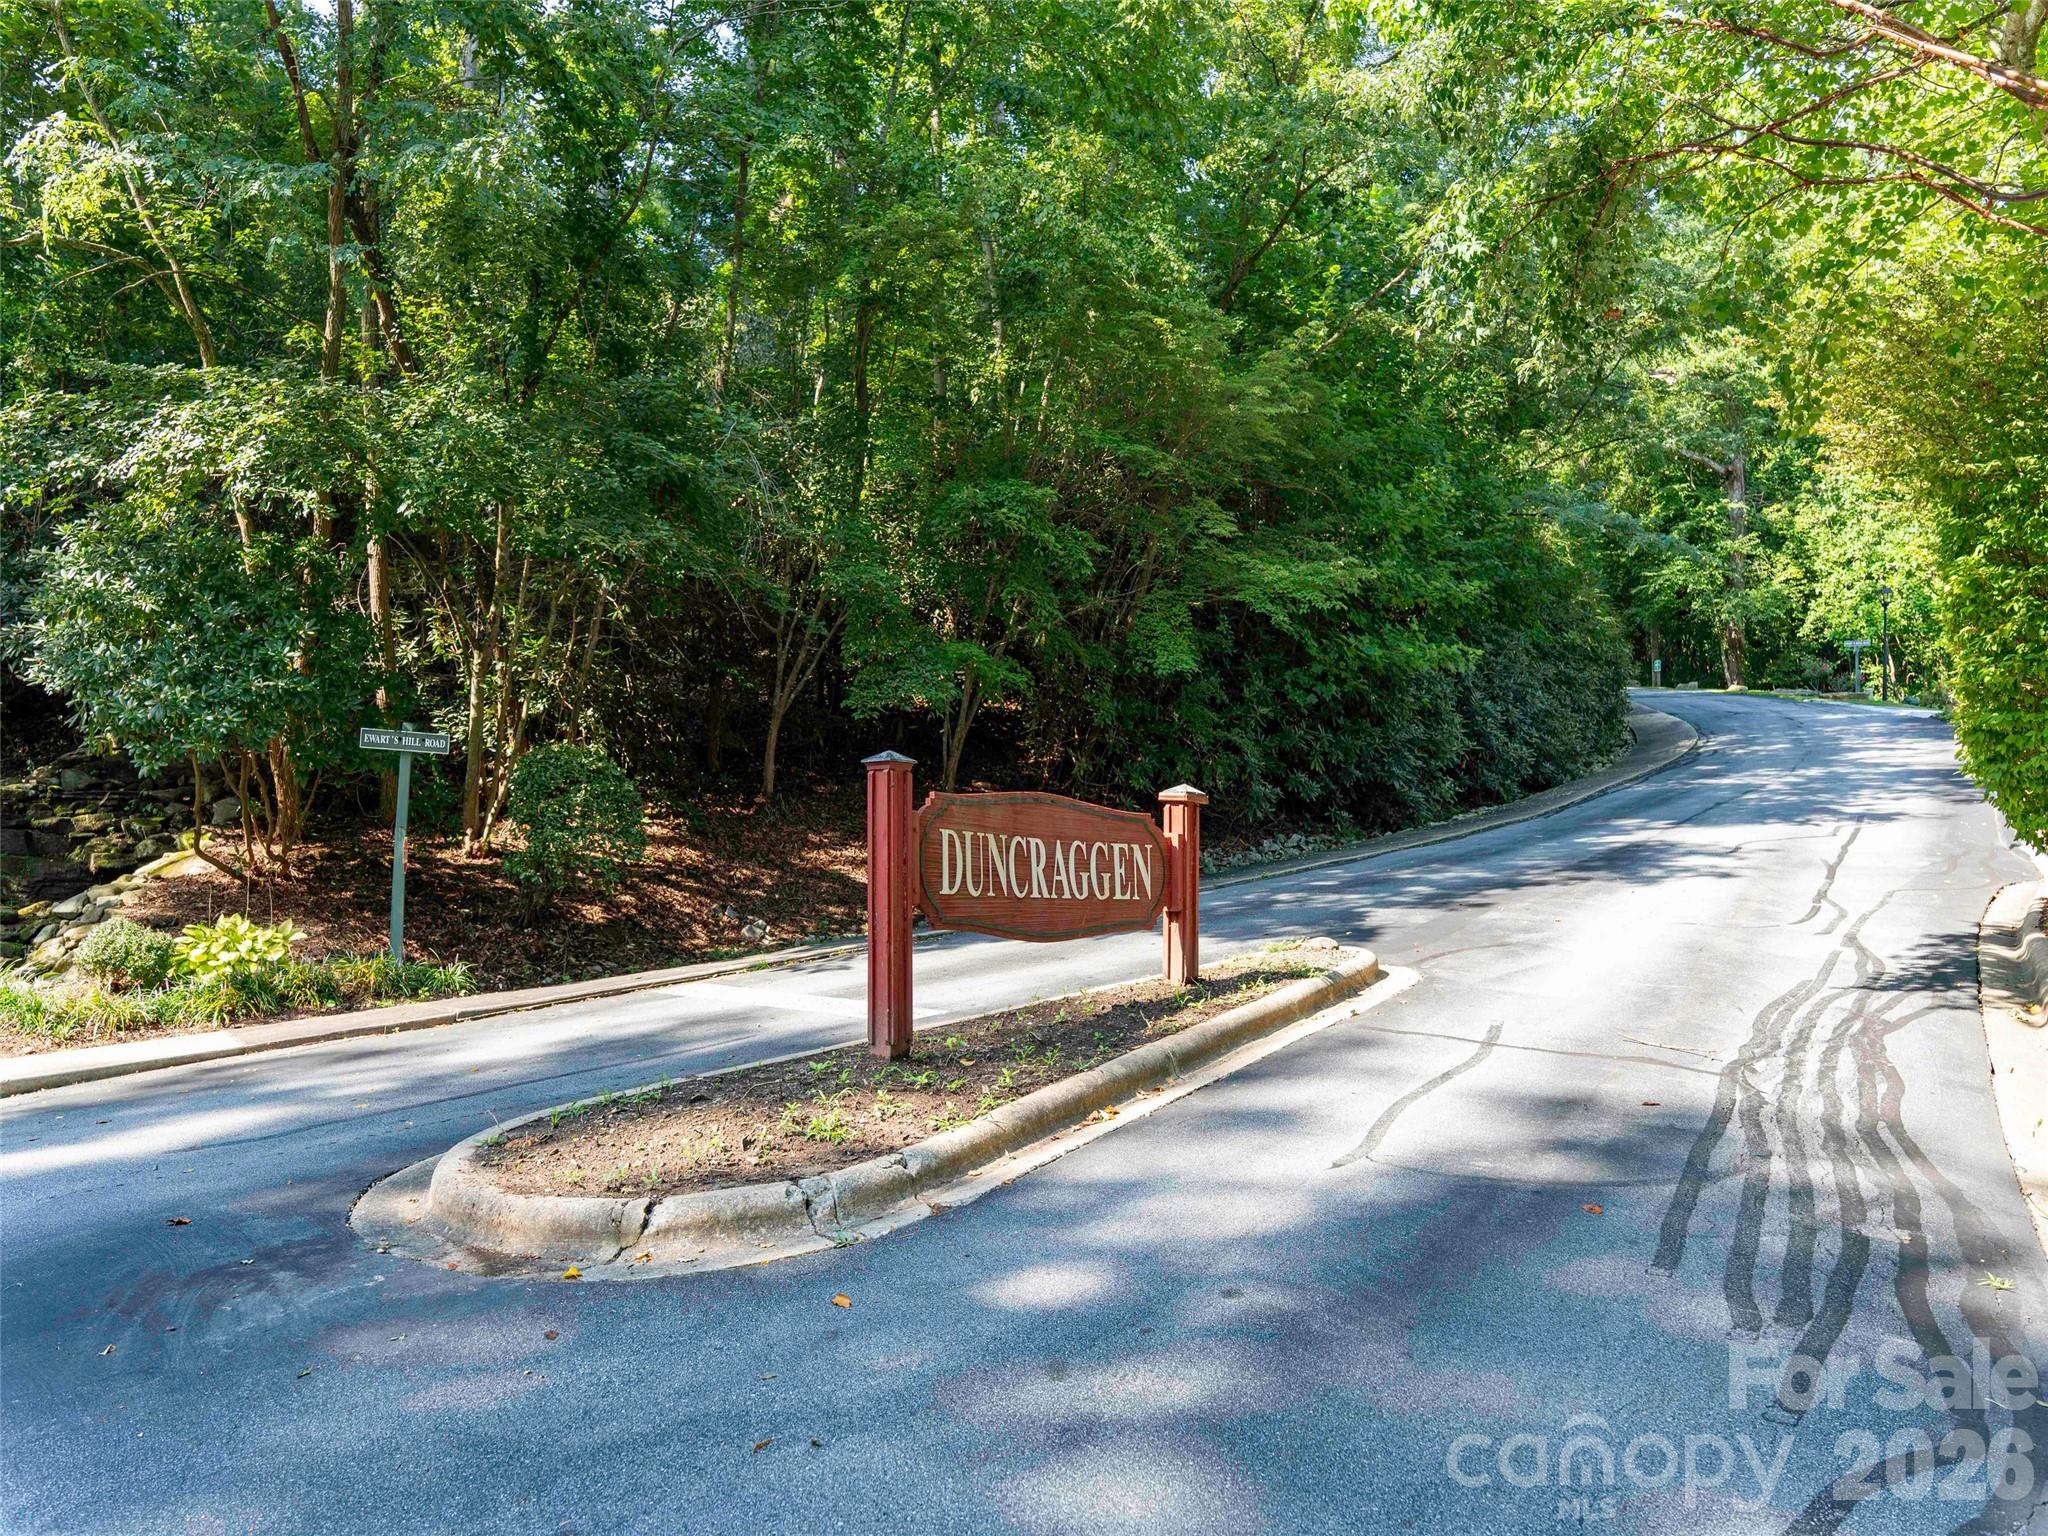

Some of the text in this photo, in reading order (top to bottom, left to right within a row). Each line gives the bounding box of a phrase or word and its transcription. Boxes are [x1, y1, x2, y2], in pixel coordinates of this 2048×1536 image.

[364, 733, 446, 749] EWART'S HILL ROAD
[939, 828, 1153, 900] DUNCRAGGEN
